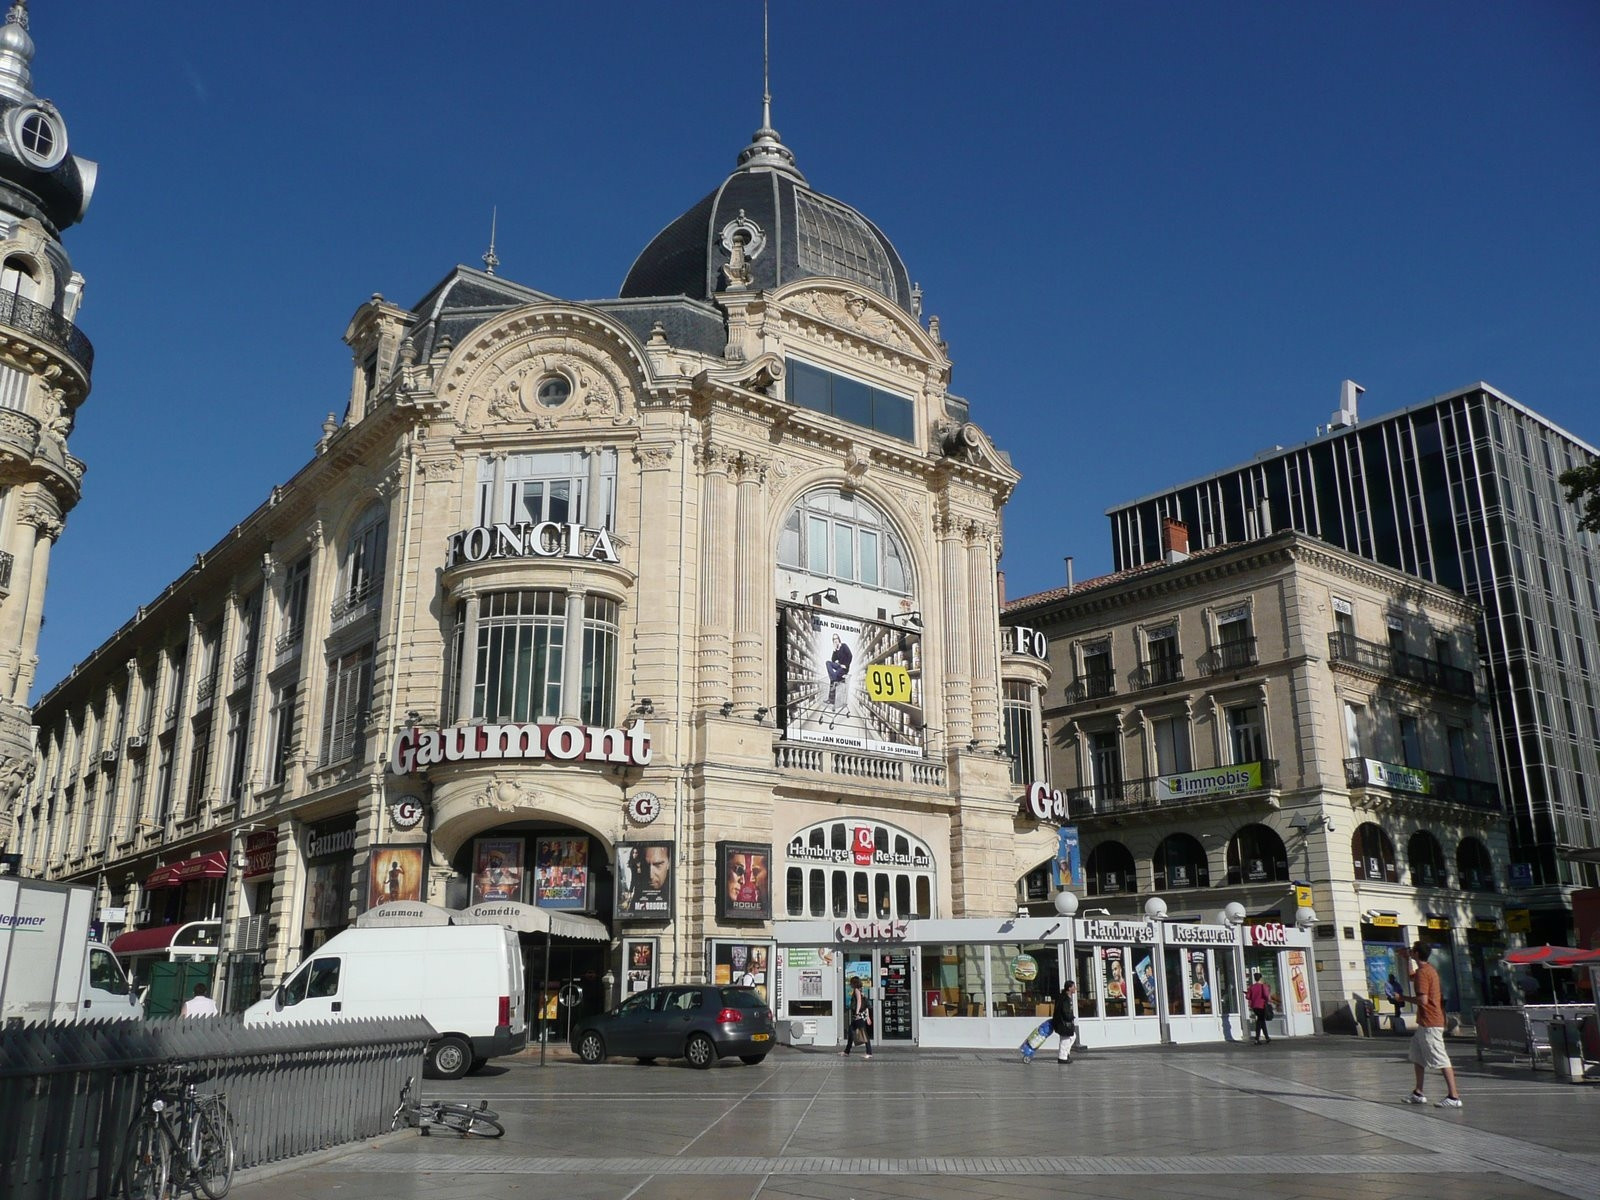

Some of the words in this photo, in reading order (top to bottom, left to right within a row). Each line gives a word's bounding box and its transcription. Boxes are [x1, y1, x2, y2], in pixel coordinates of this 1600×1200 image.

[446, 521, 620, 569] FONCIA
[813, 618, 829, 627] JEAN
[830, 622, 860, 634] DUJARDIN
[1014, 625, 1048, 659] FO
[872, 671, 894, 695] 99
[899, 673, 905, 693] F
[391, 719, 653, 775] Gaumont
[836, 737, 862, 747] KOUNEN
[1185, 770, 1250, 791] immobis
[399, 802, 416, 819] G
[635, 799, 653, 816] G
[858, 829, 872, 849] Q
[378, 909, 424, 917] Gaumont
[474, 907, 520, 917] Comédie
[733, 901, 762, 910] ROGUE
[840, 919, 907, 943] Quick
